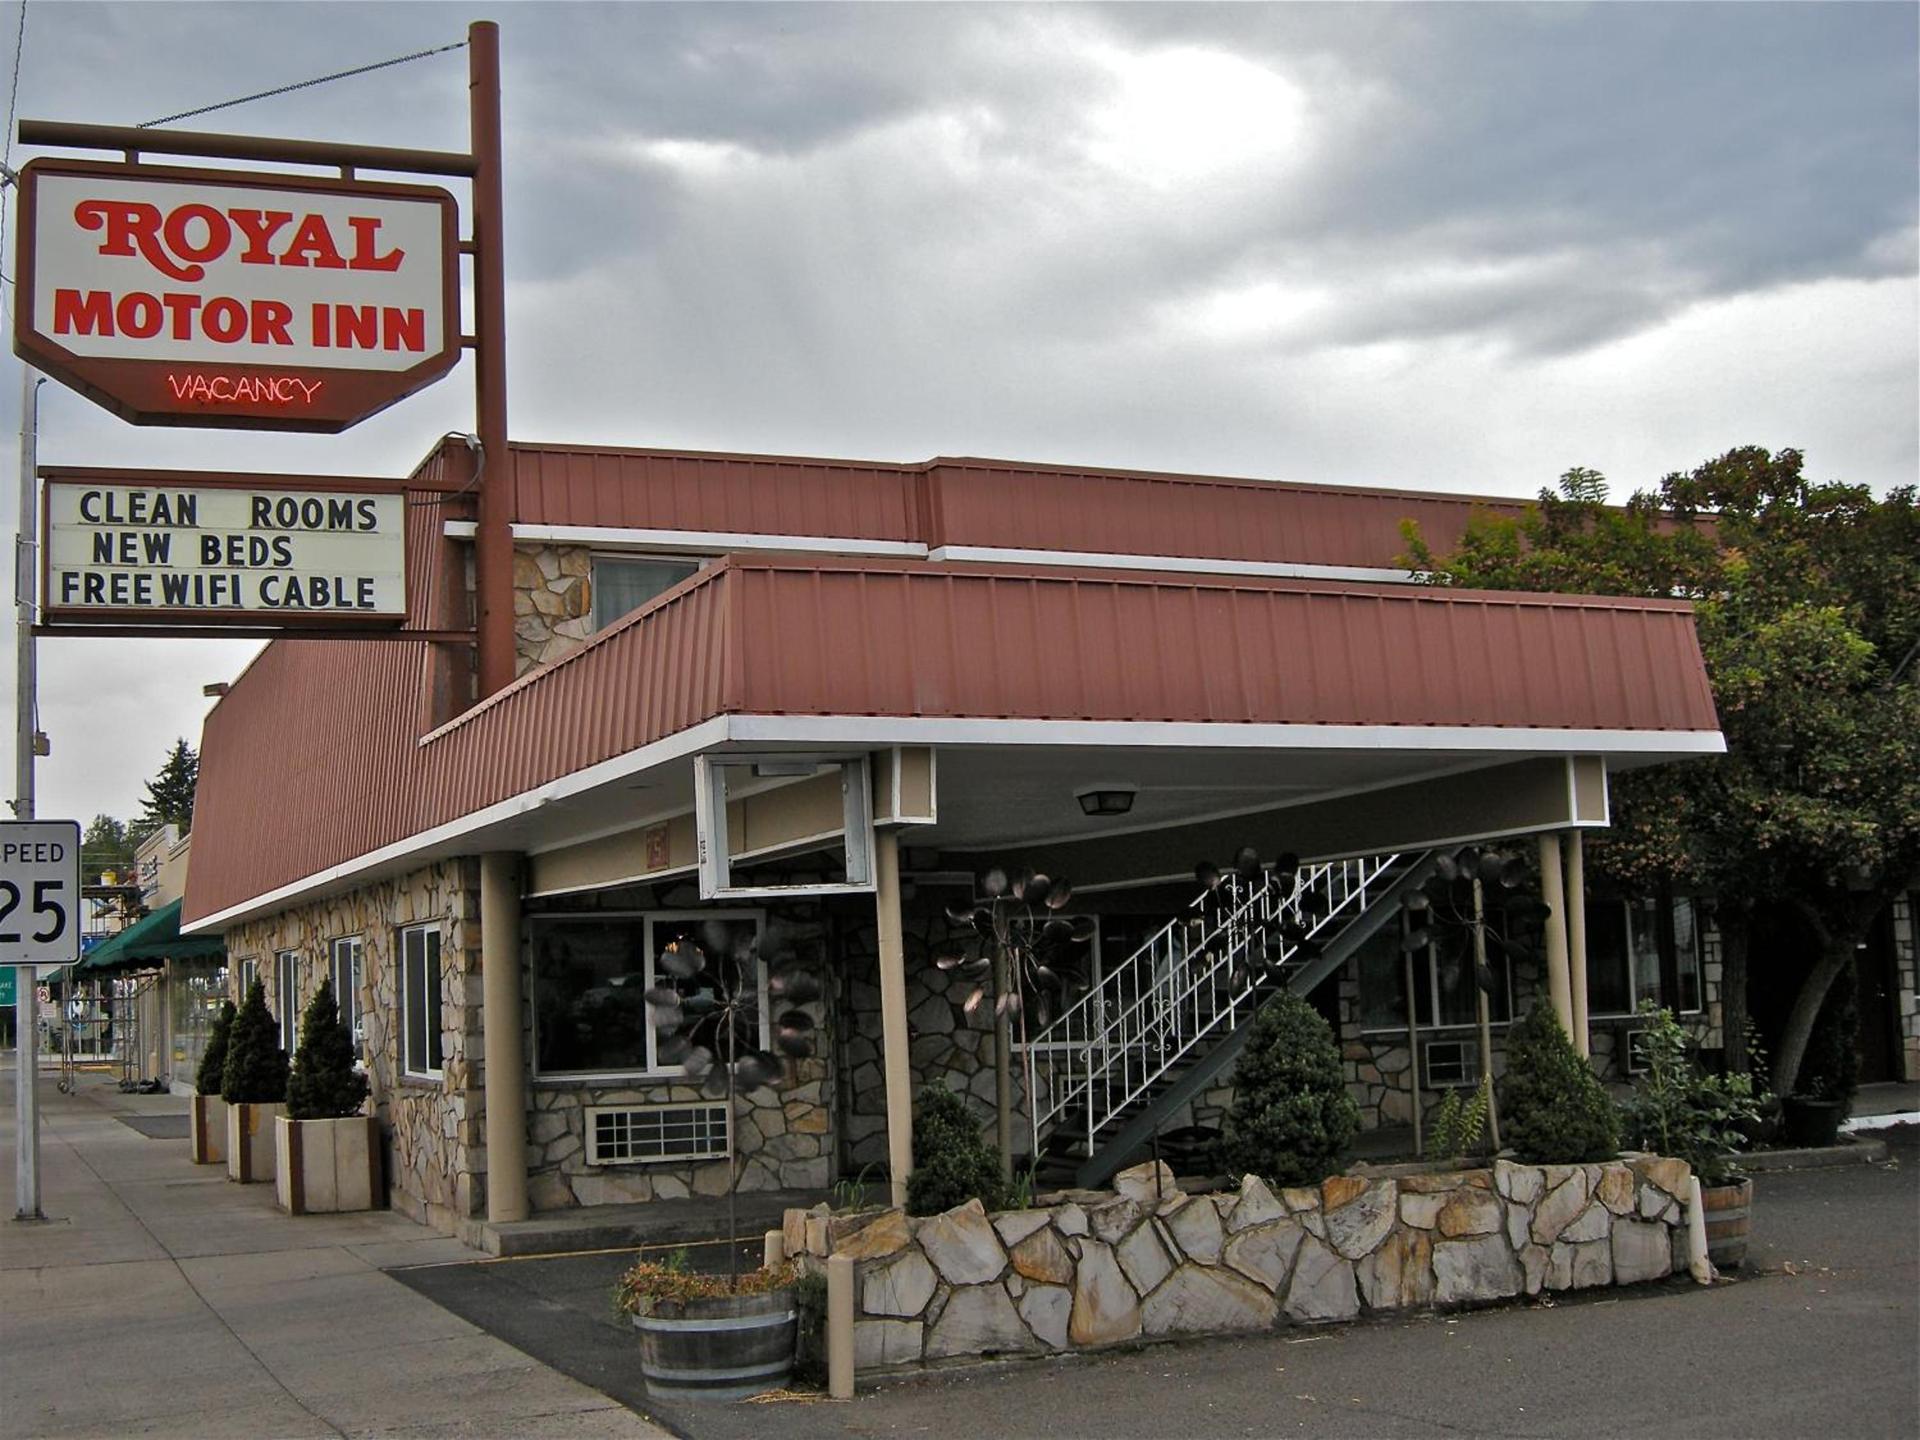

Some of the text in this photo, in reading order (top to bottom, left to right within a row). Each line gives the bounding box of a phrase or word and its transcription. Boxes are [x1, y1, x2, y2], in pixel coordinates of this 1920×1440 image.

[74, 200, 405, 282] ROYAL
[54, 289, 425, 353] MOTOR INN
[168, 374, 322, 403] VACANCY
[80, 491, 377, 530] CLEAN ROOMS
[93, 532, 293, 567] NEW BEDS
[62, 572, 375, 609] FREE WIFI CABLE
[0, 843, 64, 863] PEED
